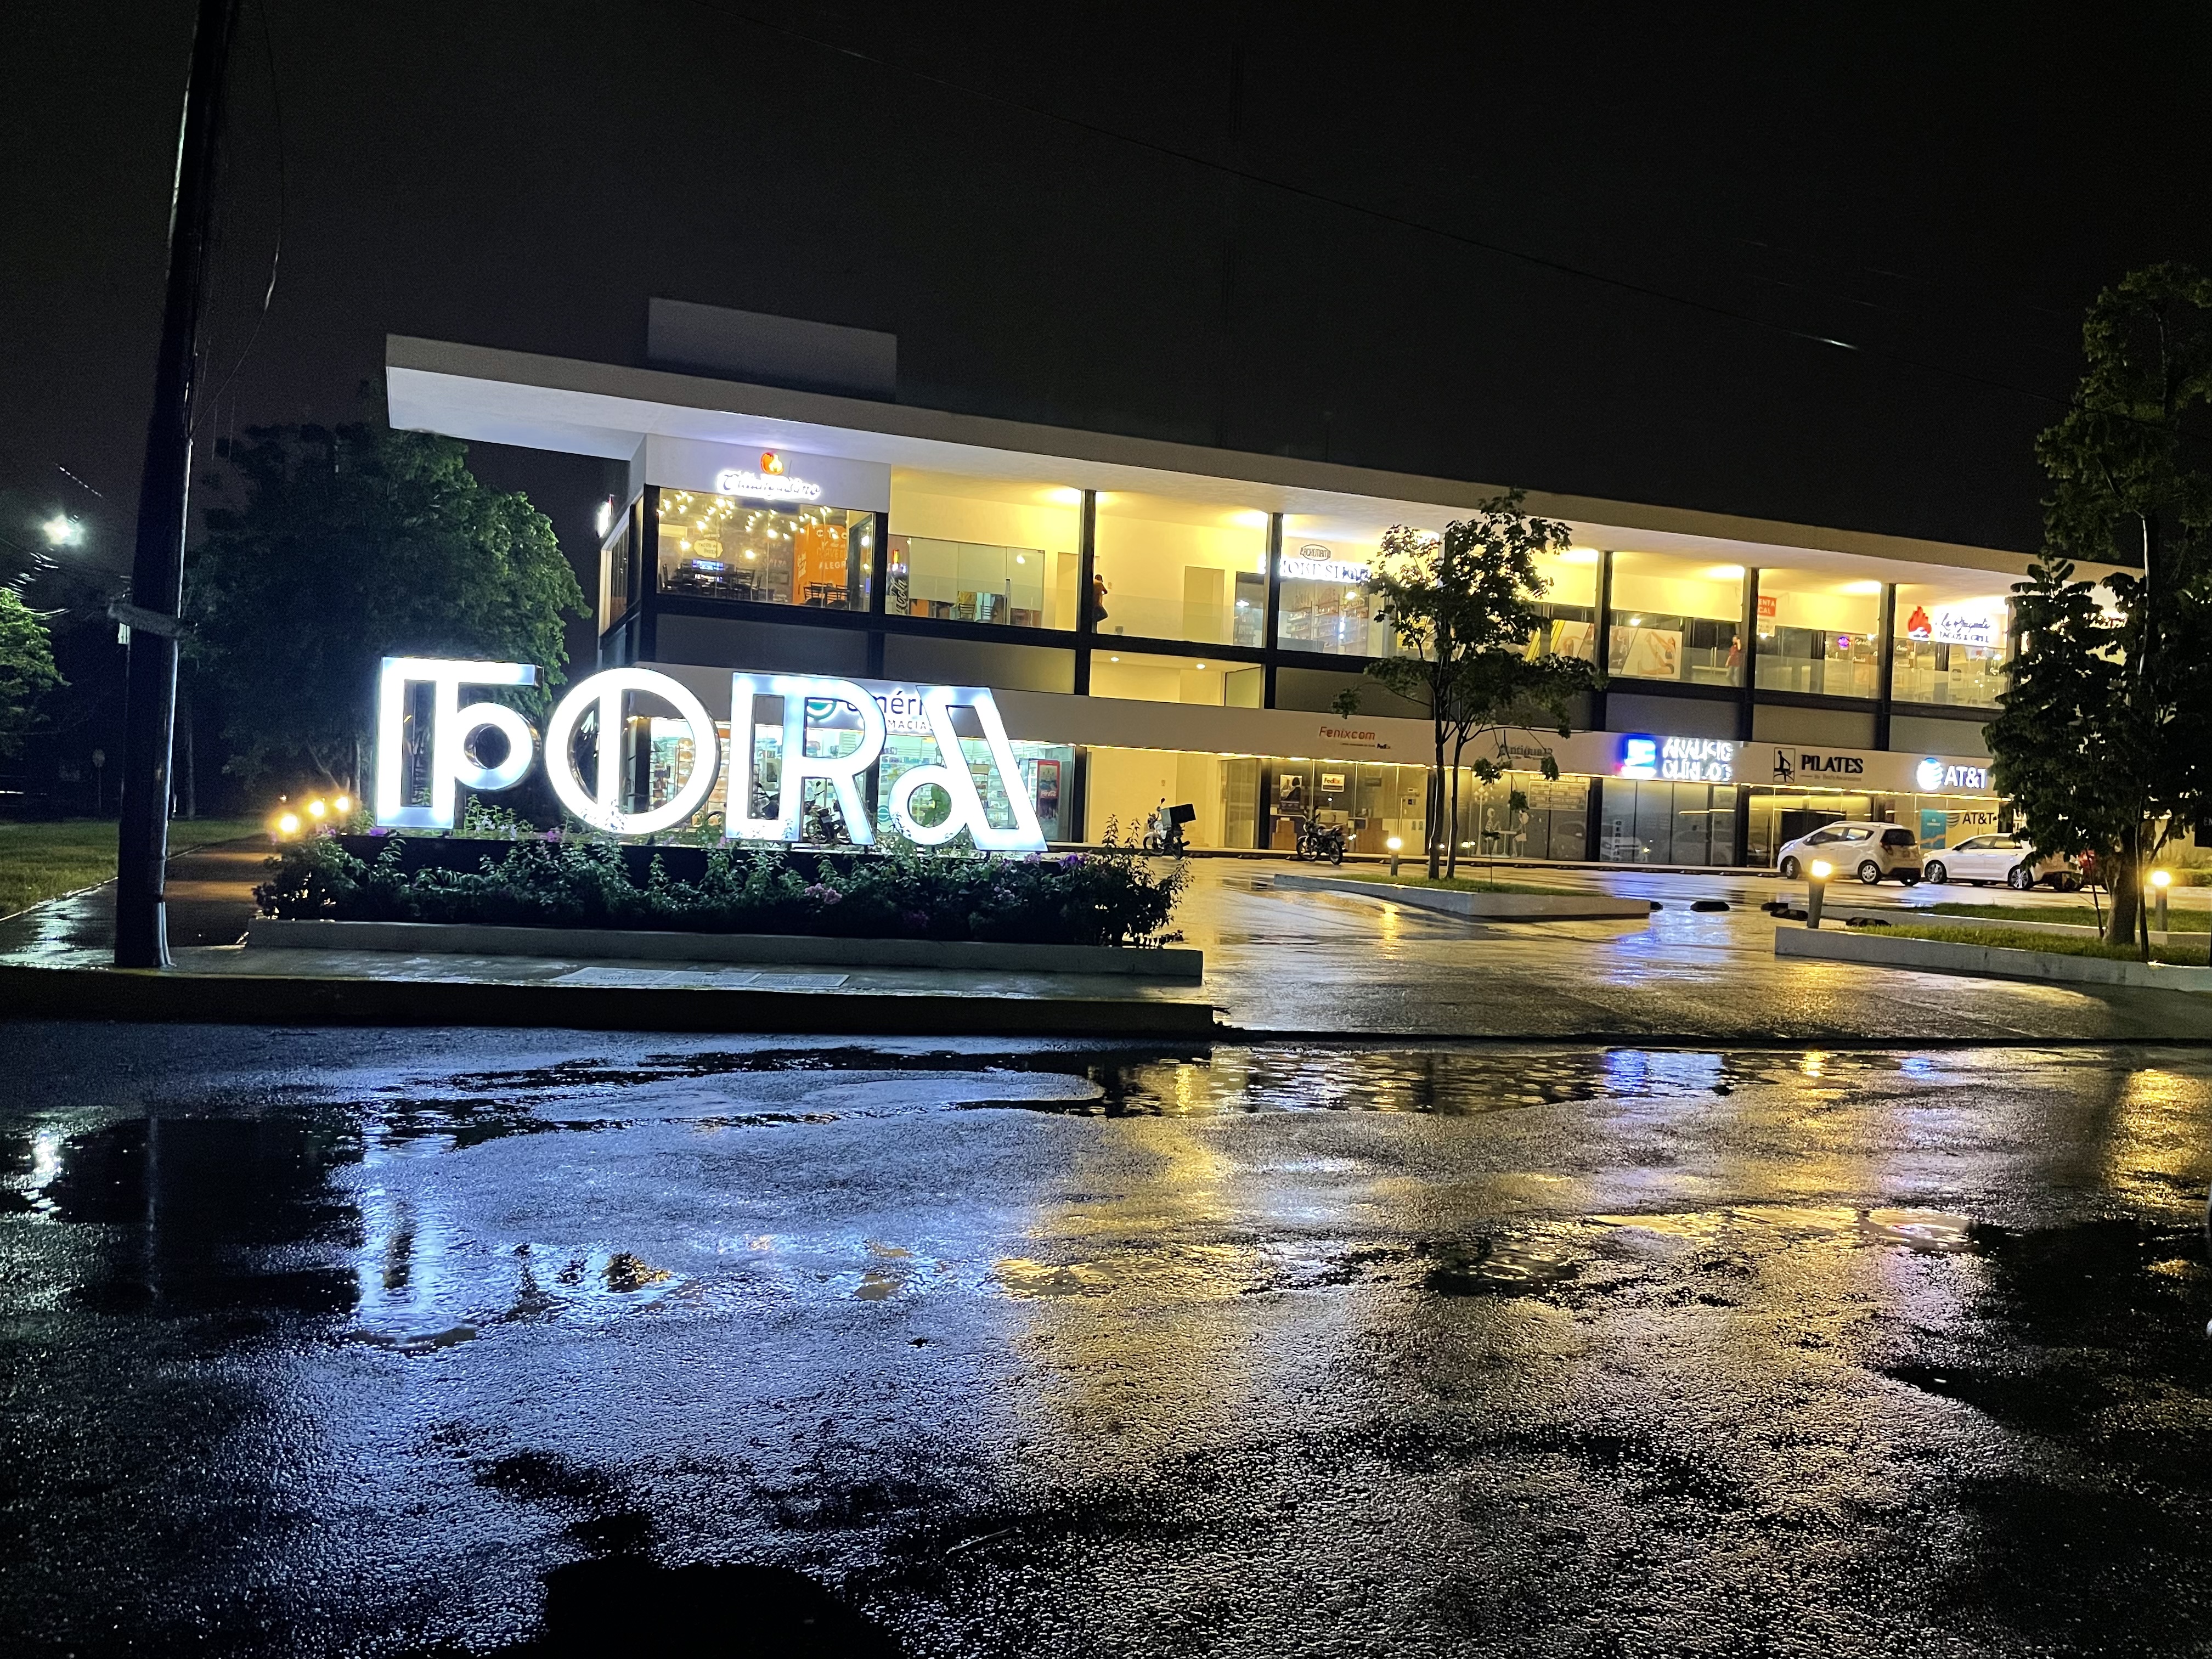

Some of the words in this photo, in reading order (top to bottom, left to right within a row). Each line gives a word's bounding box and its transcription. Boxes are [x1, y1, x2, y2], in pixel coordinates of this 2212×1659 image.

[1759, 599, 1775, 607] ENTA
[1759, 606, 1771, 614] CAL
[1319, 726, 1375, 740] Fenixcom
[1801, 754, 1864, 774] PILATES
[1944, 765, 1987, 789] AT&T
[1962, 812, 1995, 825] AT&T
